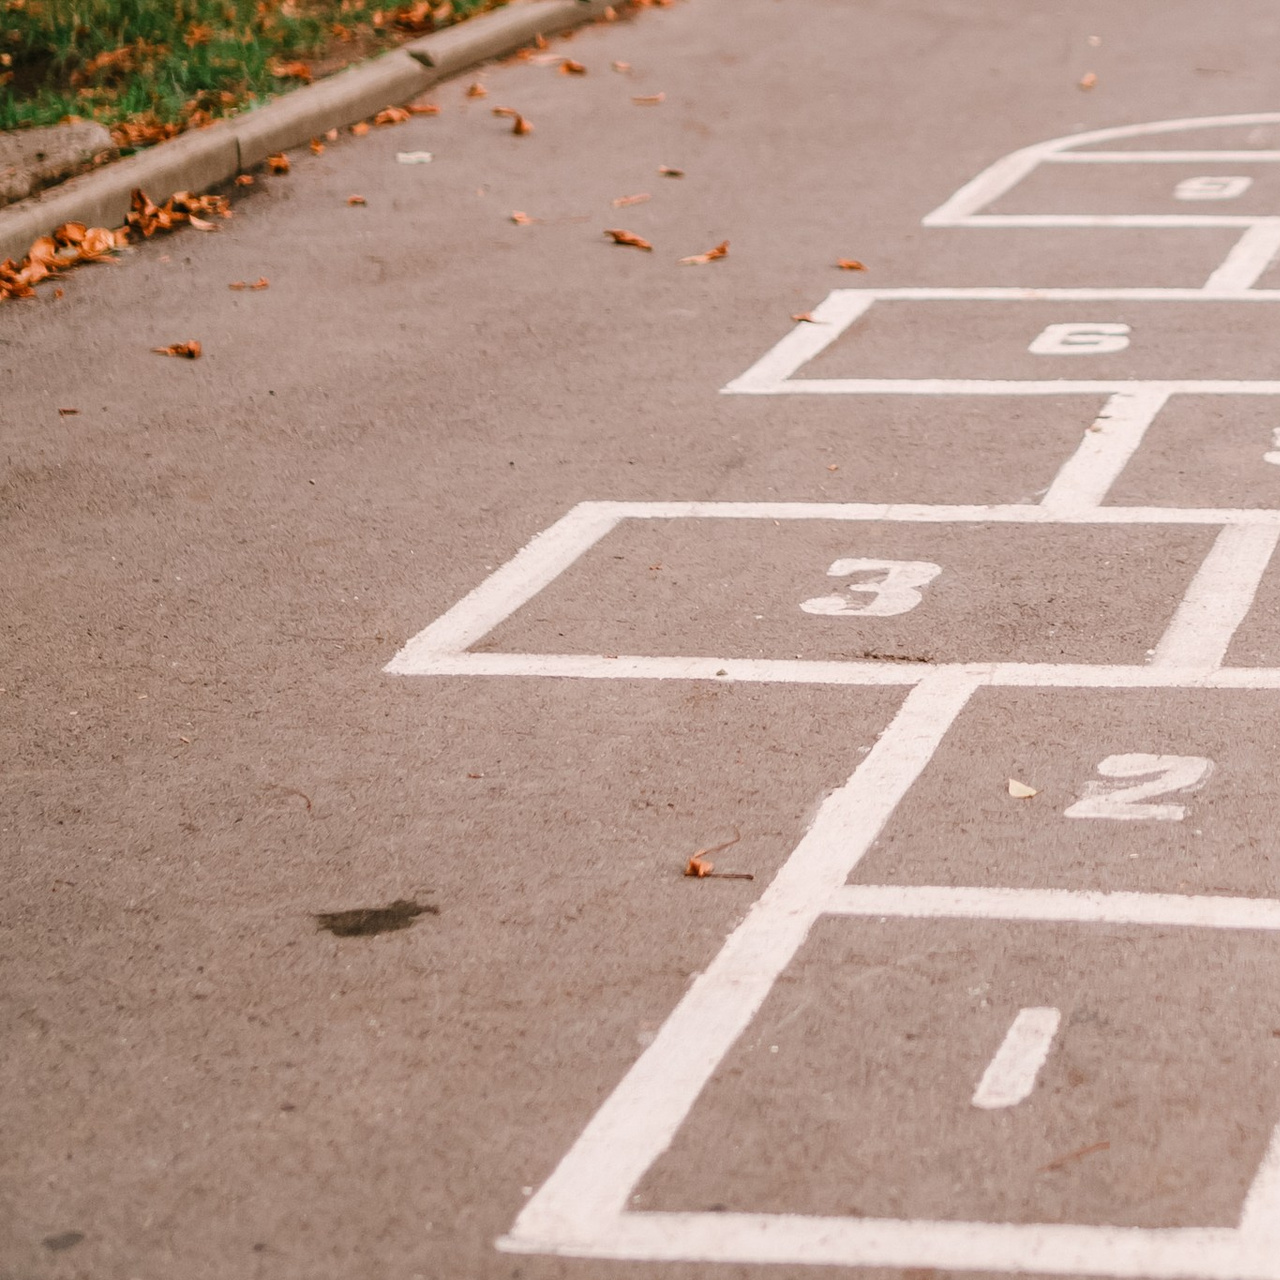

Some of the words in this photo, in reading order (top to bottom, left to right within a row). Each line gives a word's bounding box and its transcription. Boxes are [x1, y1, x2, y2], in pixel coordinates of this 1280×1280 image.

[1174, 175, 1254, 202] 9
[1027, 322, 1131, 355] 6
[799, 557, 943, 618] 3
[1063, 752, 1216, 821] 2
[972, 1006, 1062, 1108] 1
